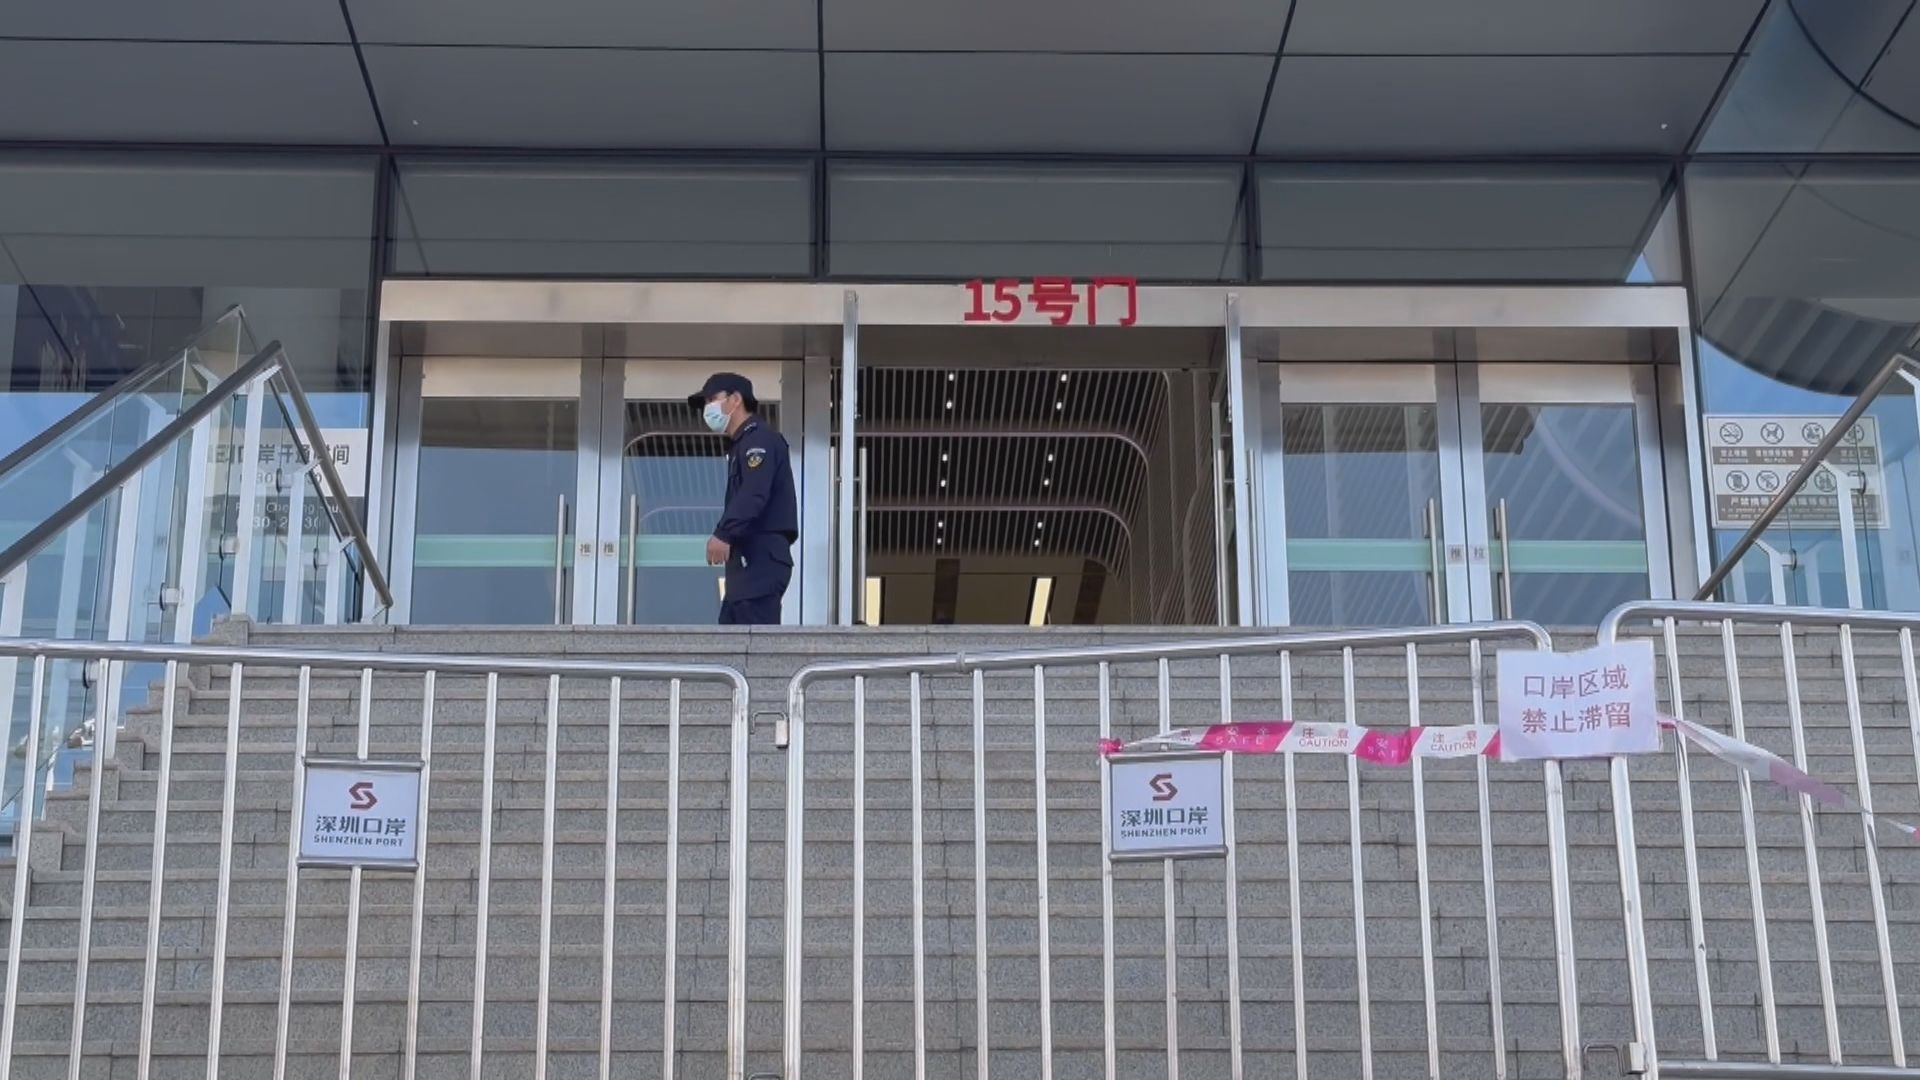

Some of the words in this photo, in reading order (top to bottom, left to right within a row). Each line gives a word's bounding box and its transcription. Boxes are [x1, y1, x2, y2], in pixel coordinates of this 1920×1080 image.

[963, 276, 1137, 326] 15号门
[1523, 663, 1629, 699] 口岸区域
[1521, 701, 1631, 733] 禁止滞留
[1298, 737, 1348, 748] CAUTION
[1430, 740, 1476, 753] CAUTION
[315, 814, 407, 837] 深圳口岸
[1120, 806, 1209, 827] 深圳口岸
[314, 834, 372, 845] SHENZHEN
[375, 838, 404, 847] PORT
[1120, 828, 1177, 839] SHENZHEN
[1180, 827, 1208, 836] PORT
